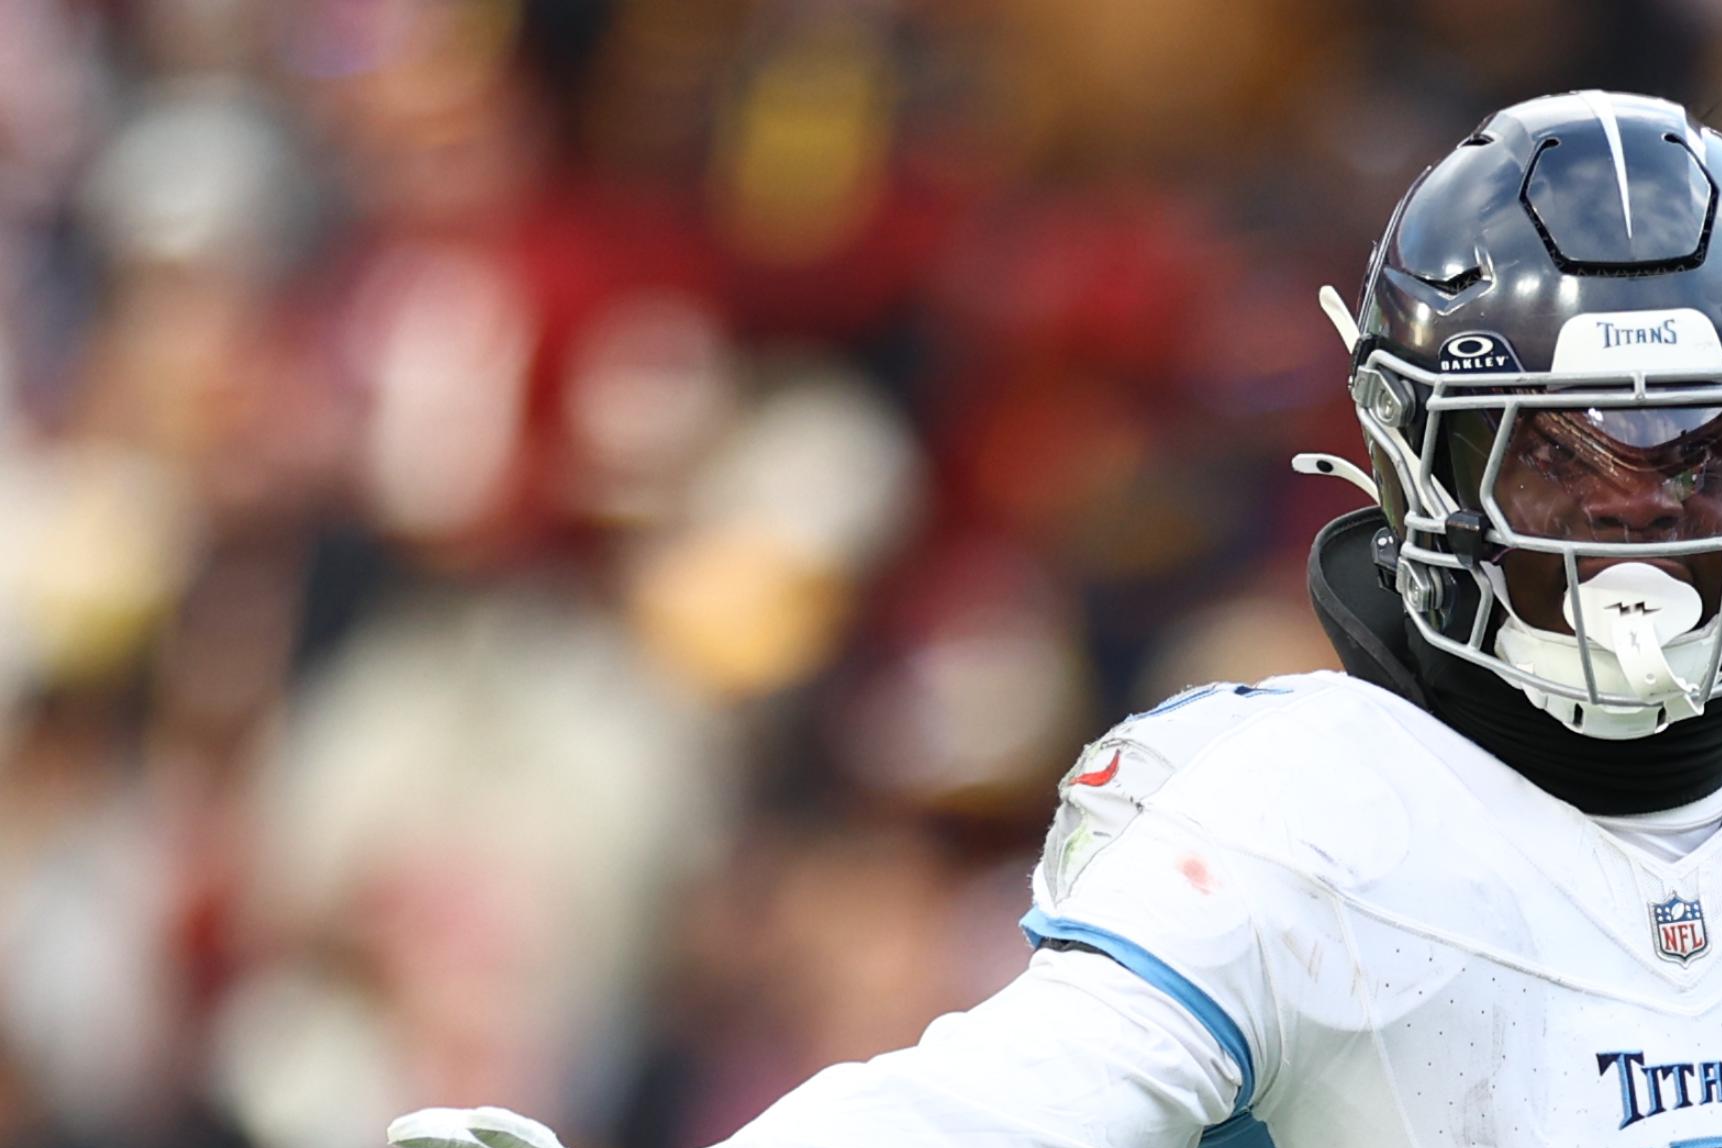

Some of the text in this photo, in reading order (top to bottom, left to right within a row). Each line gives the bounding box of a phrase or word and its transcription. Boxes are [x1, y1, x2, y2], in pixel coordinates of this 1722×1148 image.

[1596, 318, 1678, 350] TITANS
[1440, 355, 1506, 371] OAKLEY
[1662, 923, 1703, 955] NFL
